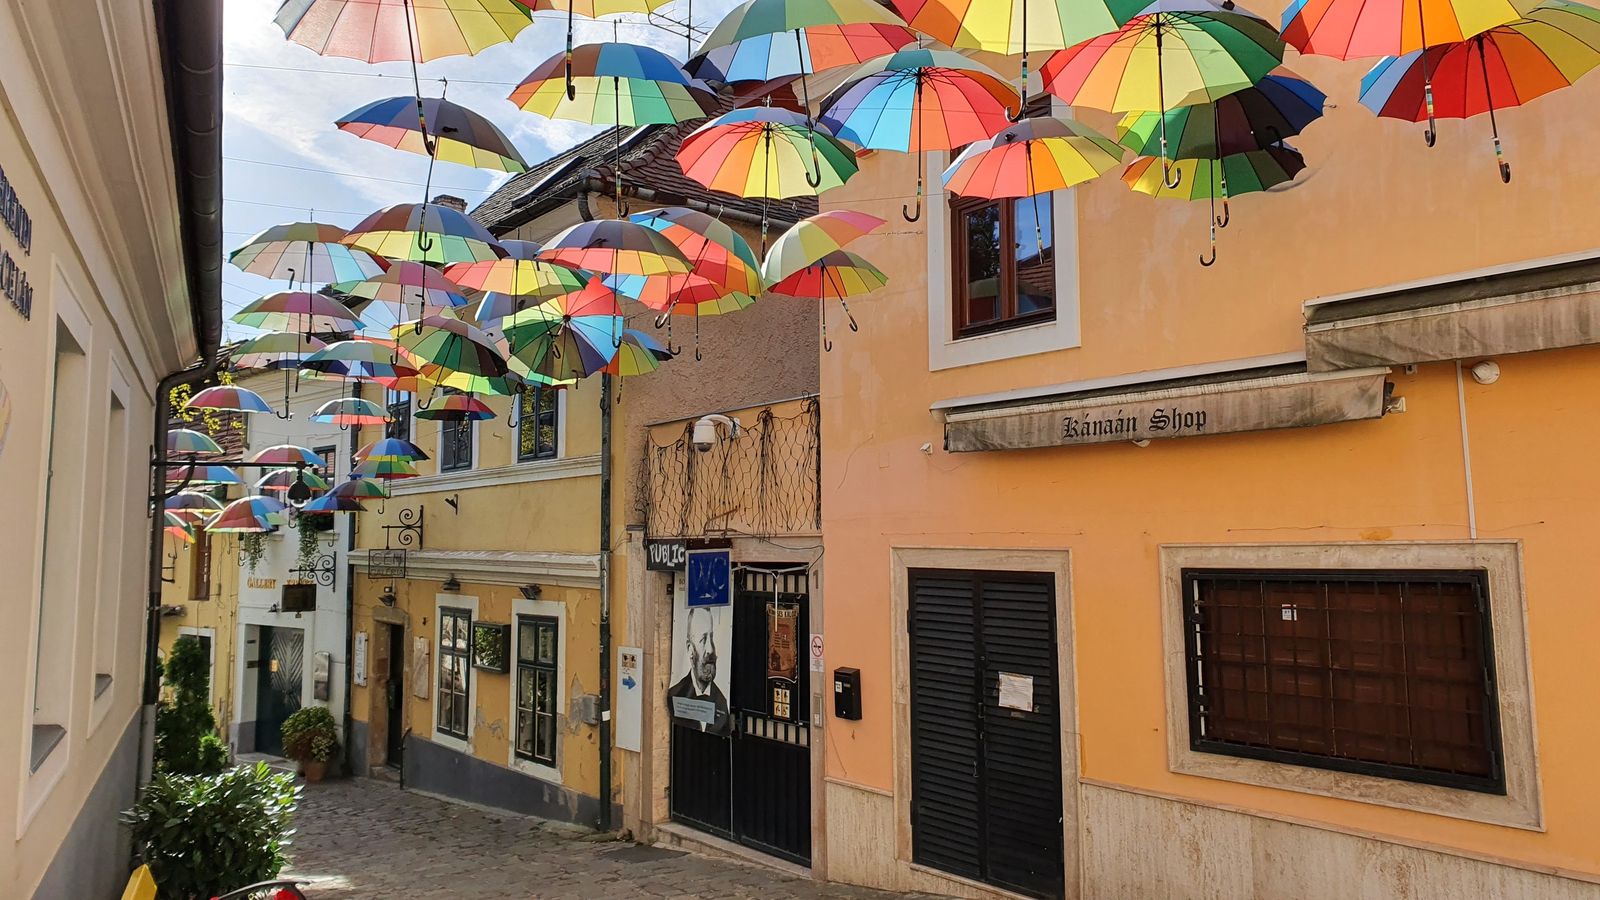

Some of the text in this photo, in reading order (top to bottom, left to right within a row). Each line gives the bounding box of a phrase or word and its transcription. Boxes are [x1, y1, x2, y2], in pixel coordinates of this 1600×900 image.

[1063, 407, 1207, 439] Kánaán Shop
[649, 543, 685, 567] PUBLIC
